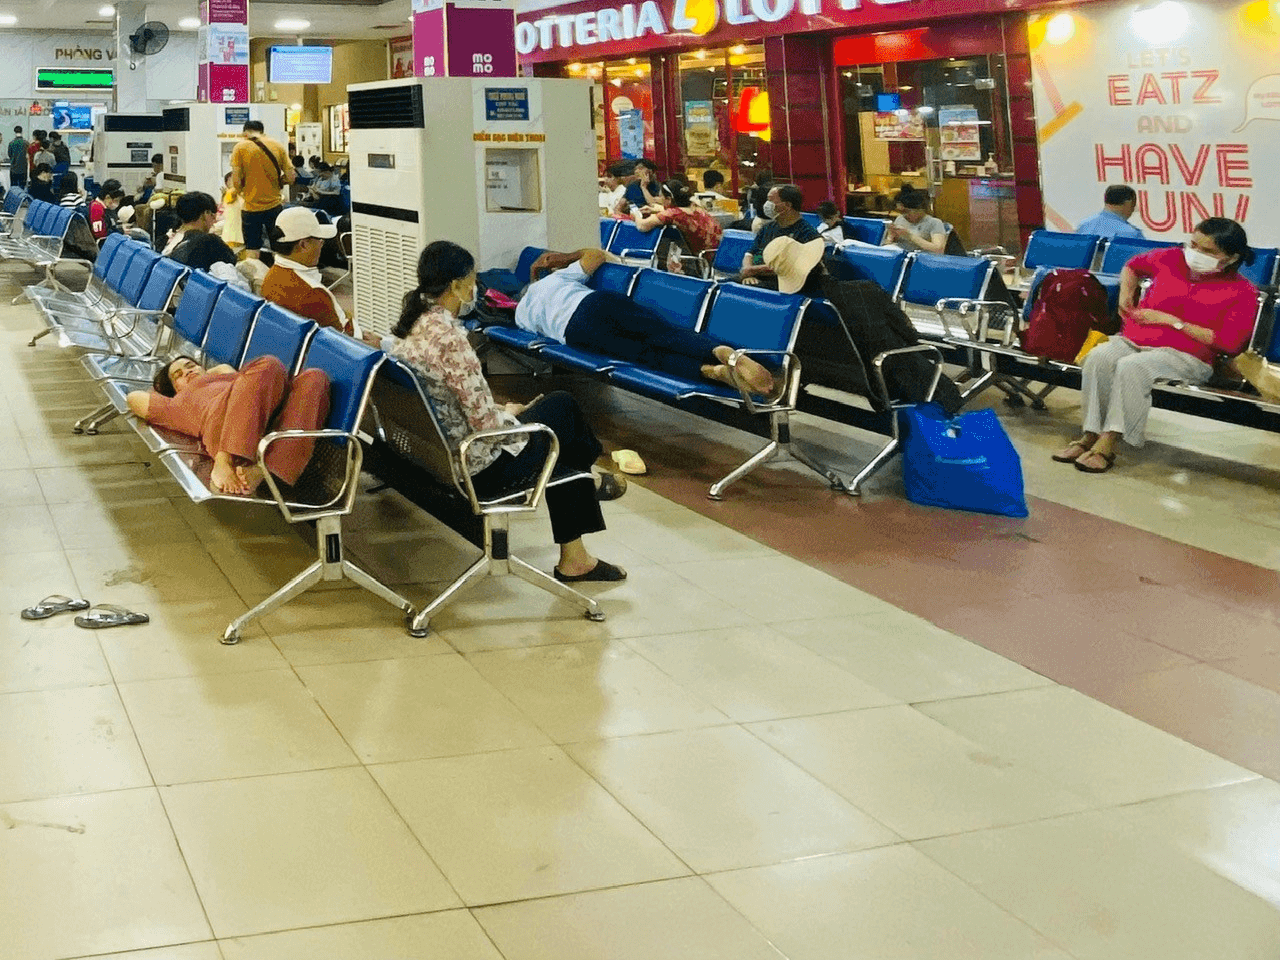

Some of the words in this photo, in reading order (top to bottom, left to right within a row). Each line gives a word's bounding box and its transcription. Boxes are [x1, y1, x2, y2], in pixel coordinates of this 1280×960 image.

[516, 1, 666, 54] OTTERIA
[55, 45, 102, 60] PHÒNG
[106, 48, 117, 60] V
[1107, 69, 1221, 107] EATZ
[1137, 115, 1193, 134] AND
[1095, 143, 1253, 188] HAVE
[1139, 190, 1250, 234] UN!
